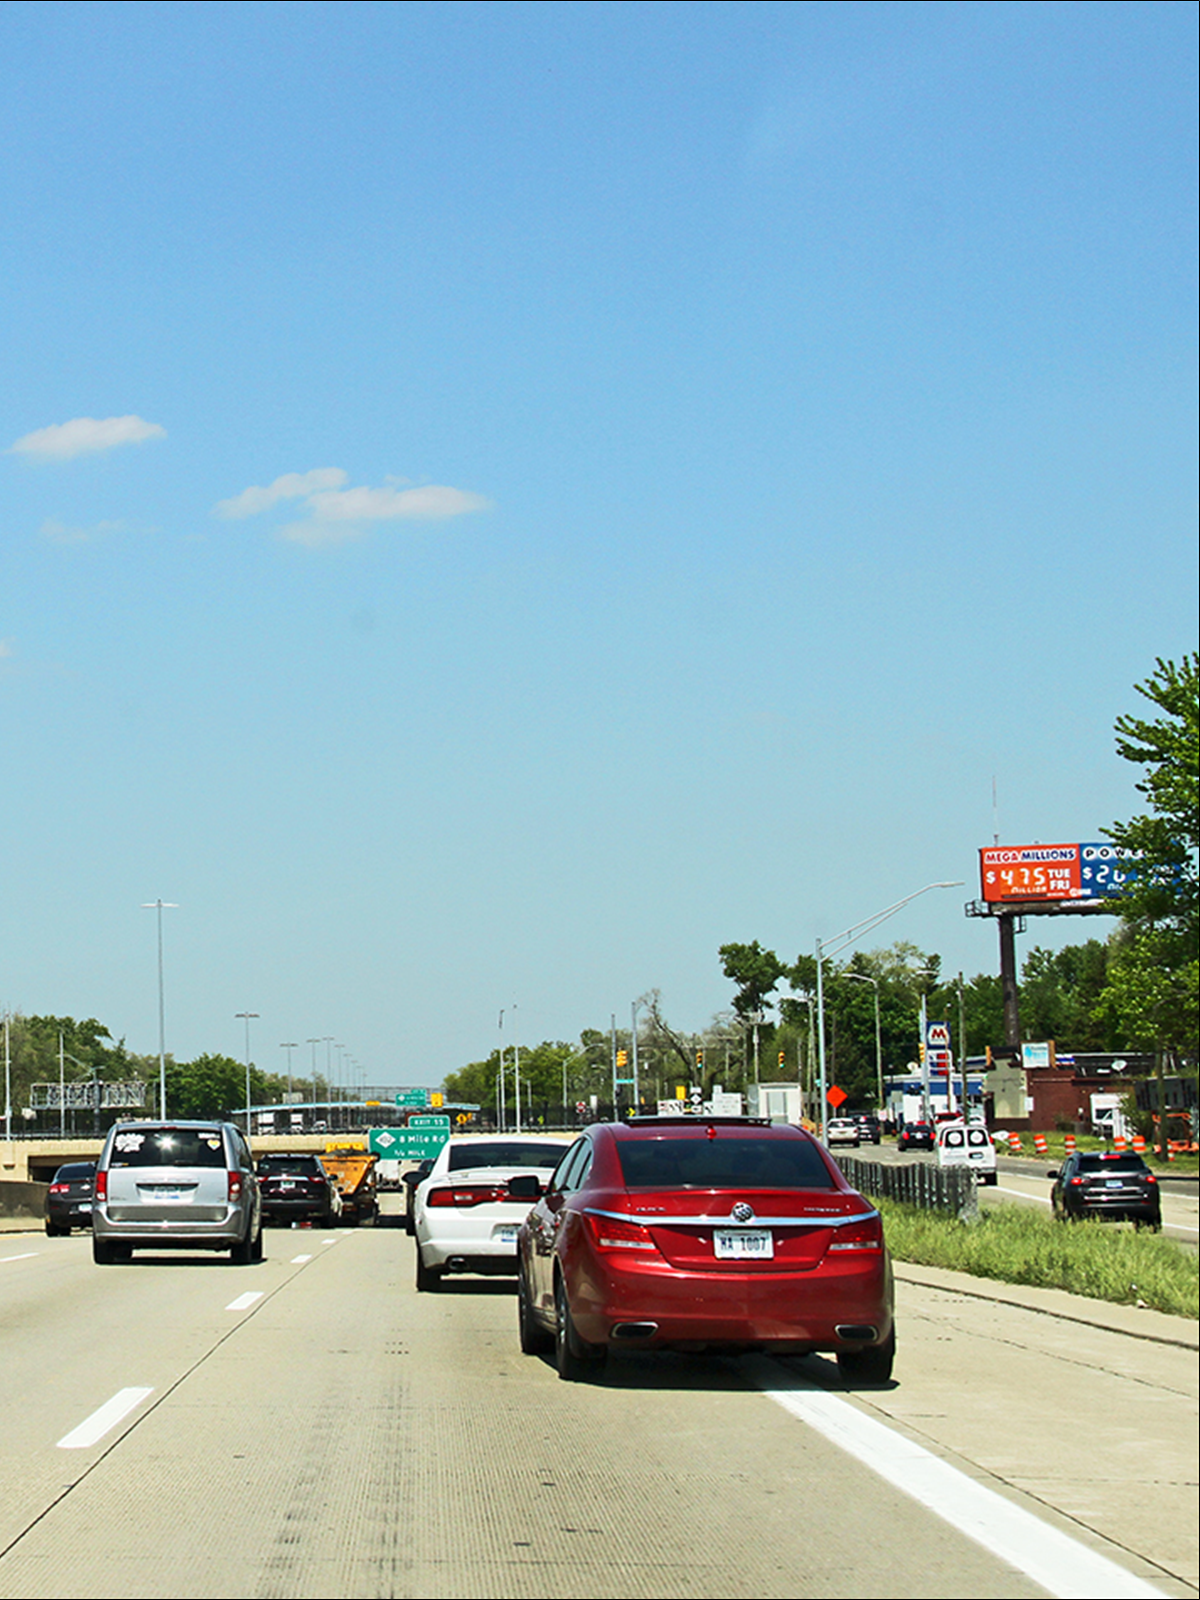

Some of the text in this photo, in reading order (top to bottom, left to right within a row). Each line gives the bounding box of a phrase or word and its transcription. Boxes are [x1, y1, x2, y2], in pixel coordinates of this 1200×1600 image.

[984, 848, 1076, 863] MEGA MILLIONS
[1048, 869, 1071, 879] TUE
[1050, 879, 1070, 890] FRI
[407, 1134, 430, 1143] Mile
[432, 1135, 446, 1143] Rd
